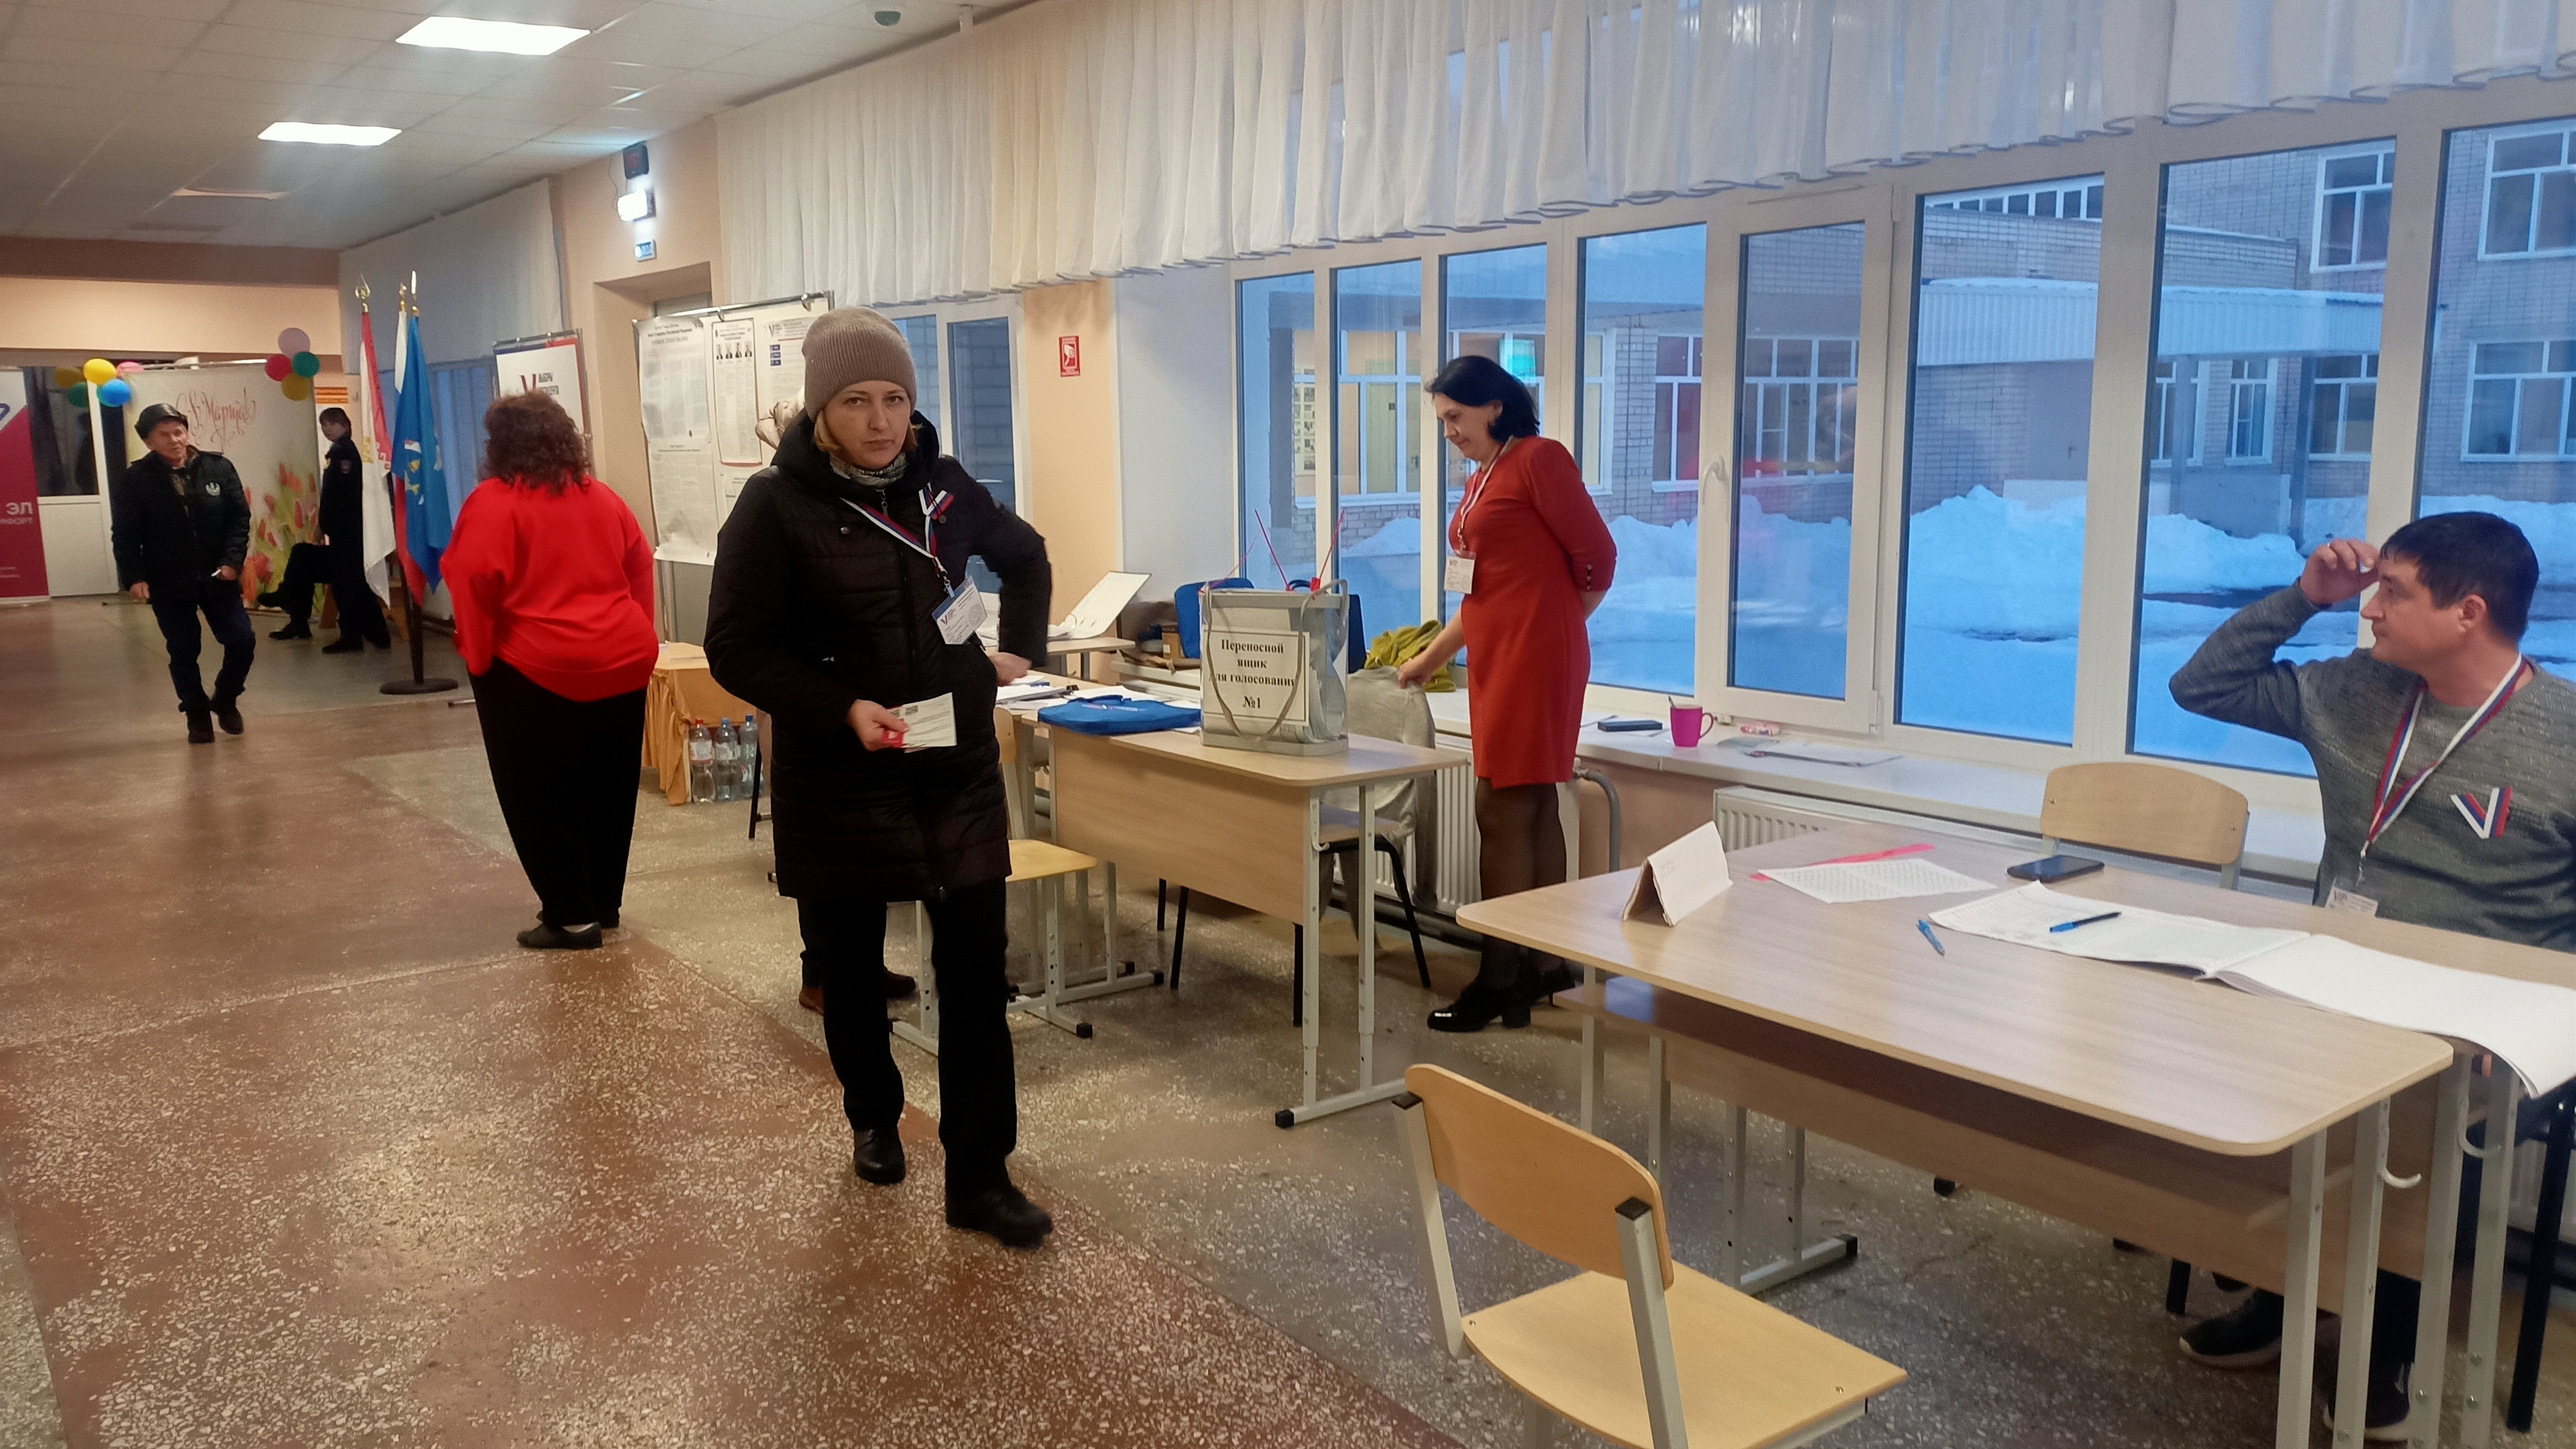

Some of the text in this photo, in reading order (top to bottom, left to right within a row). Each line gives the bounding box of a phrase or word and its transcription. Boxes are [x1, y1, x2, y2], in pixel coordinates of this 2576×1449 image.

[1221, 639, 1284, 654] Переносной
[1237, 658, 1268, 669] ящик
[1242, 695, 1261, 709] №1
